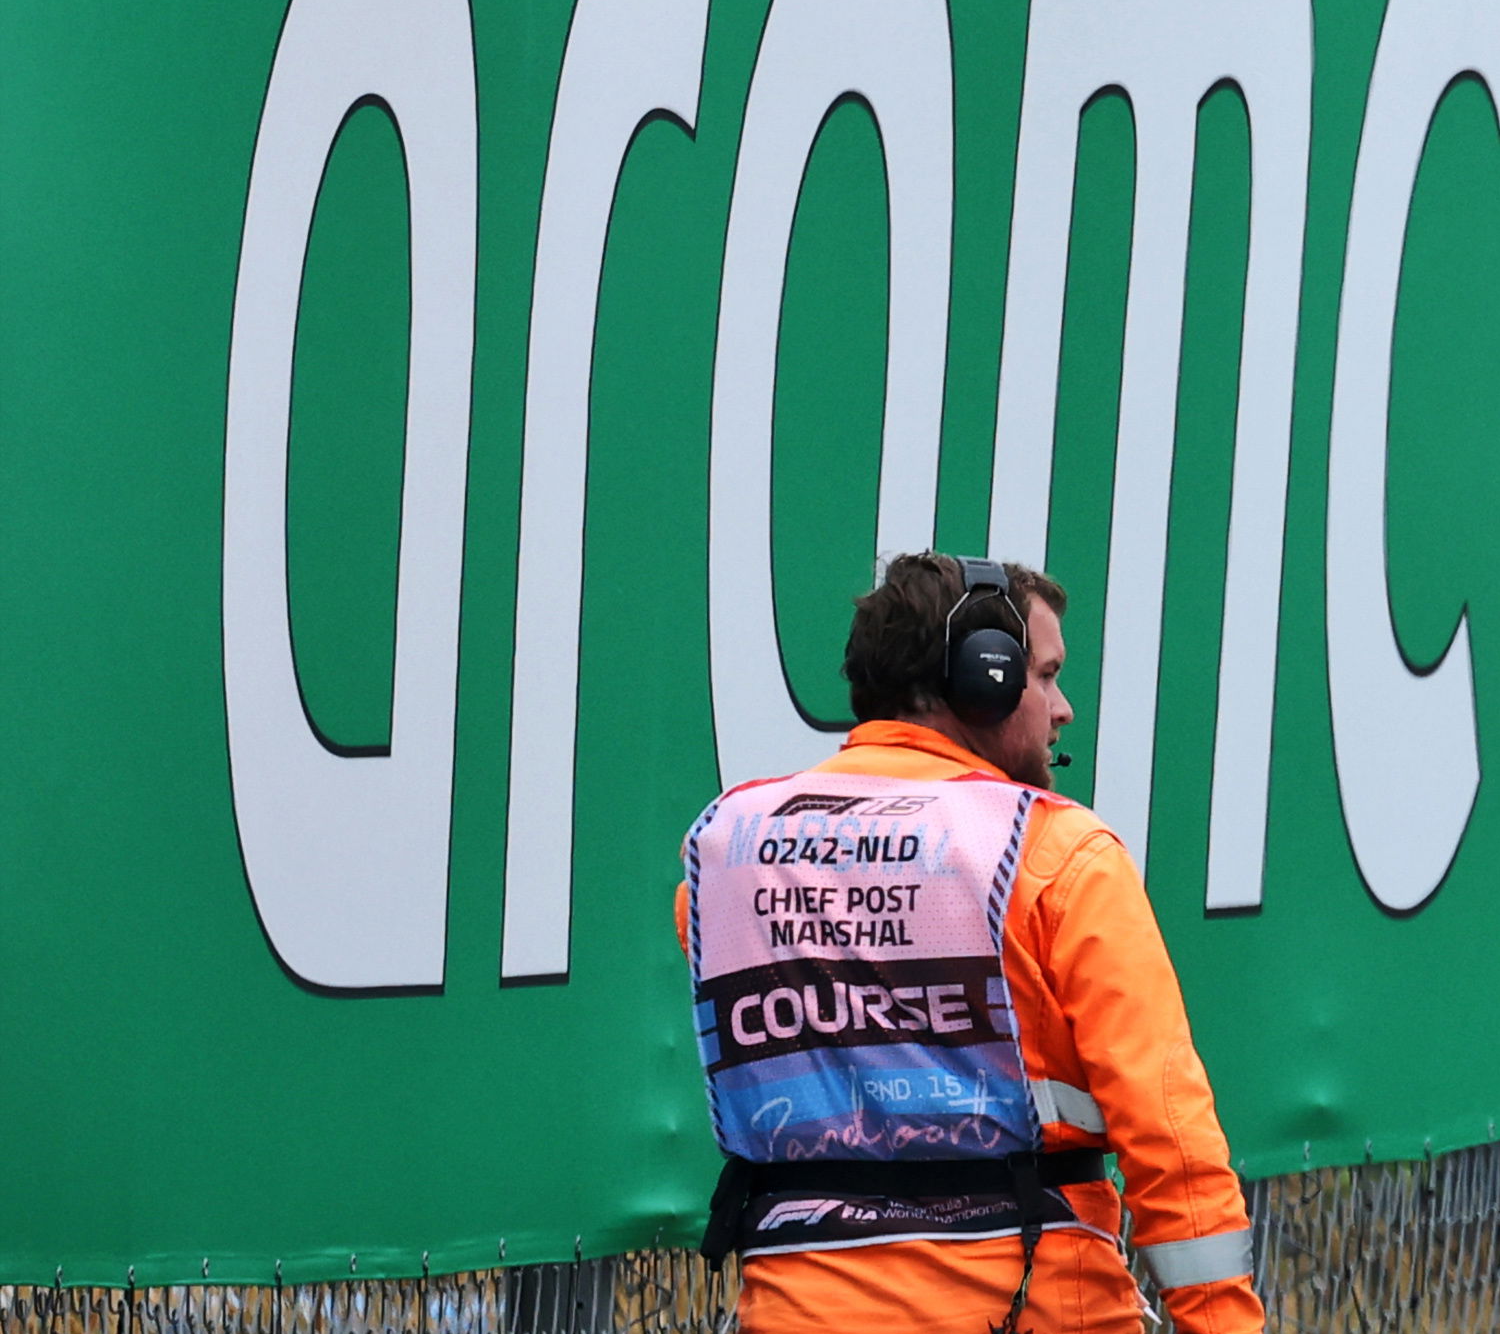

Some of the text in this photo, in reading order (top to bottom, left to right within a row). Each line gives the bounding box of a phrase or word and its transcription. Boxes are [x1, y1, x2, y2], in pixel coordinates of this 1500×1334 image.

[758, 835, 920, 865] 0242-NLD
[753, 884, 921, 917] CHIEF POST
[769, 918, 914, 948] MARSHAL
[730, 980, 974, 1047] COURSE
[841, 1204, 879, 1222] FIA
